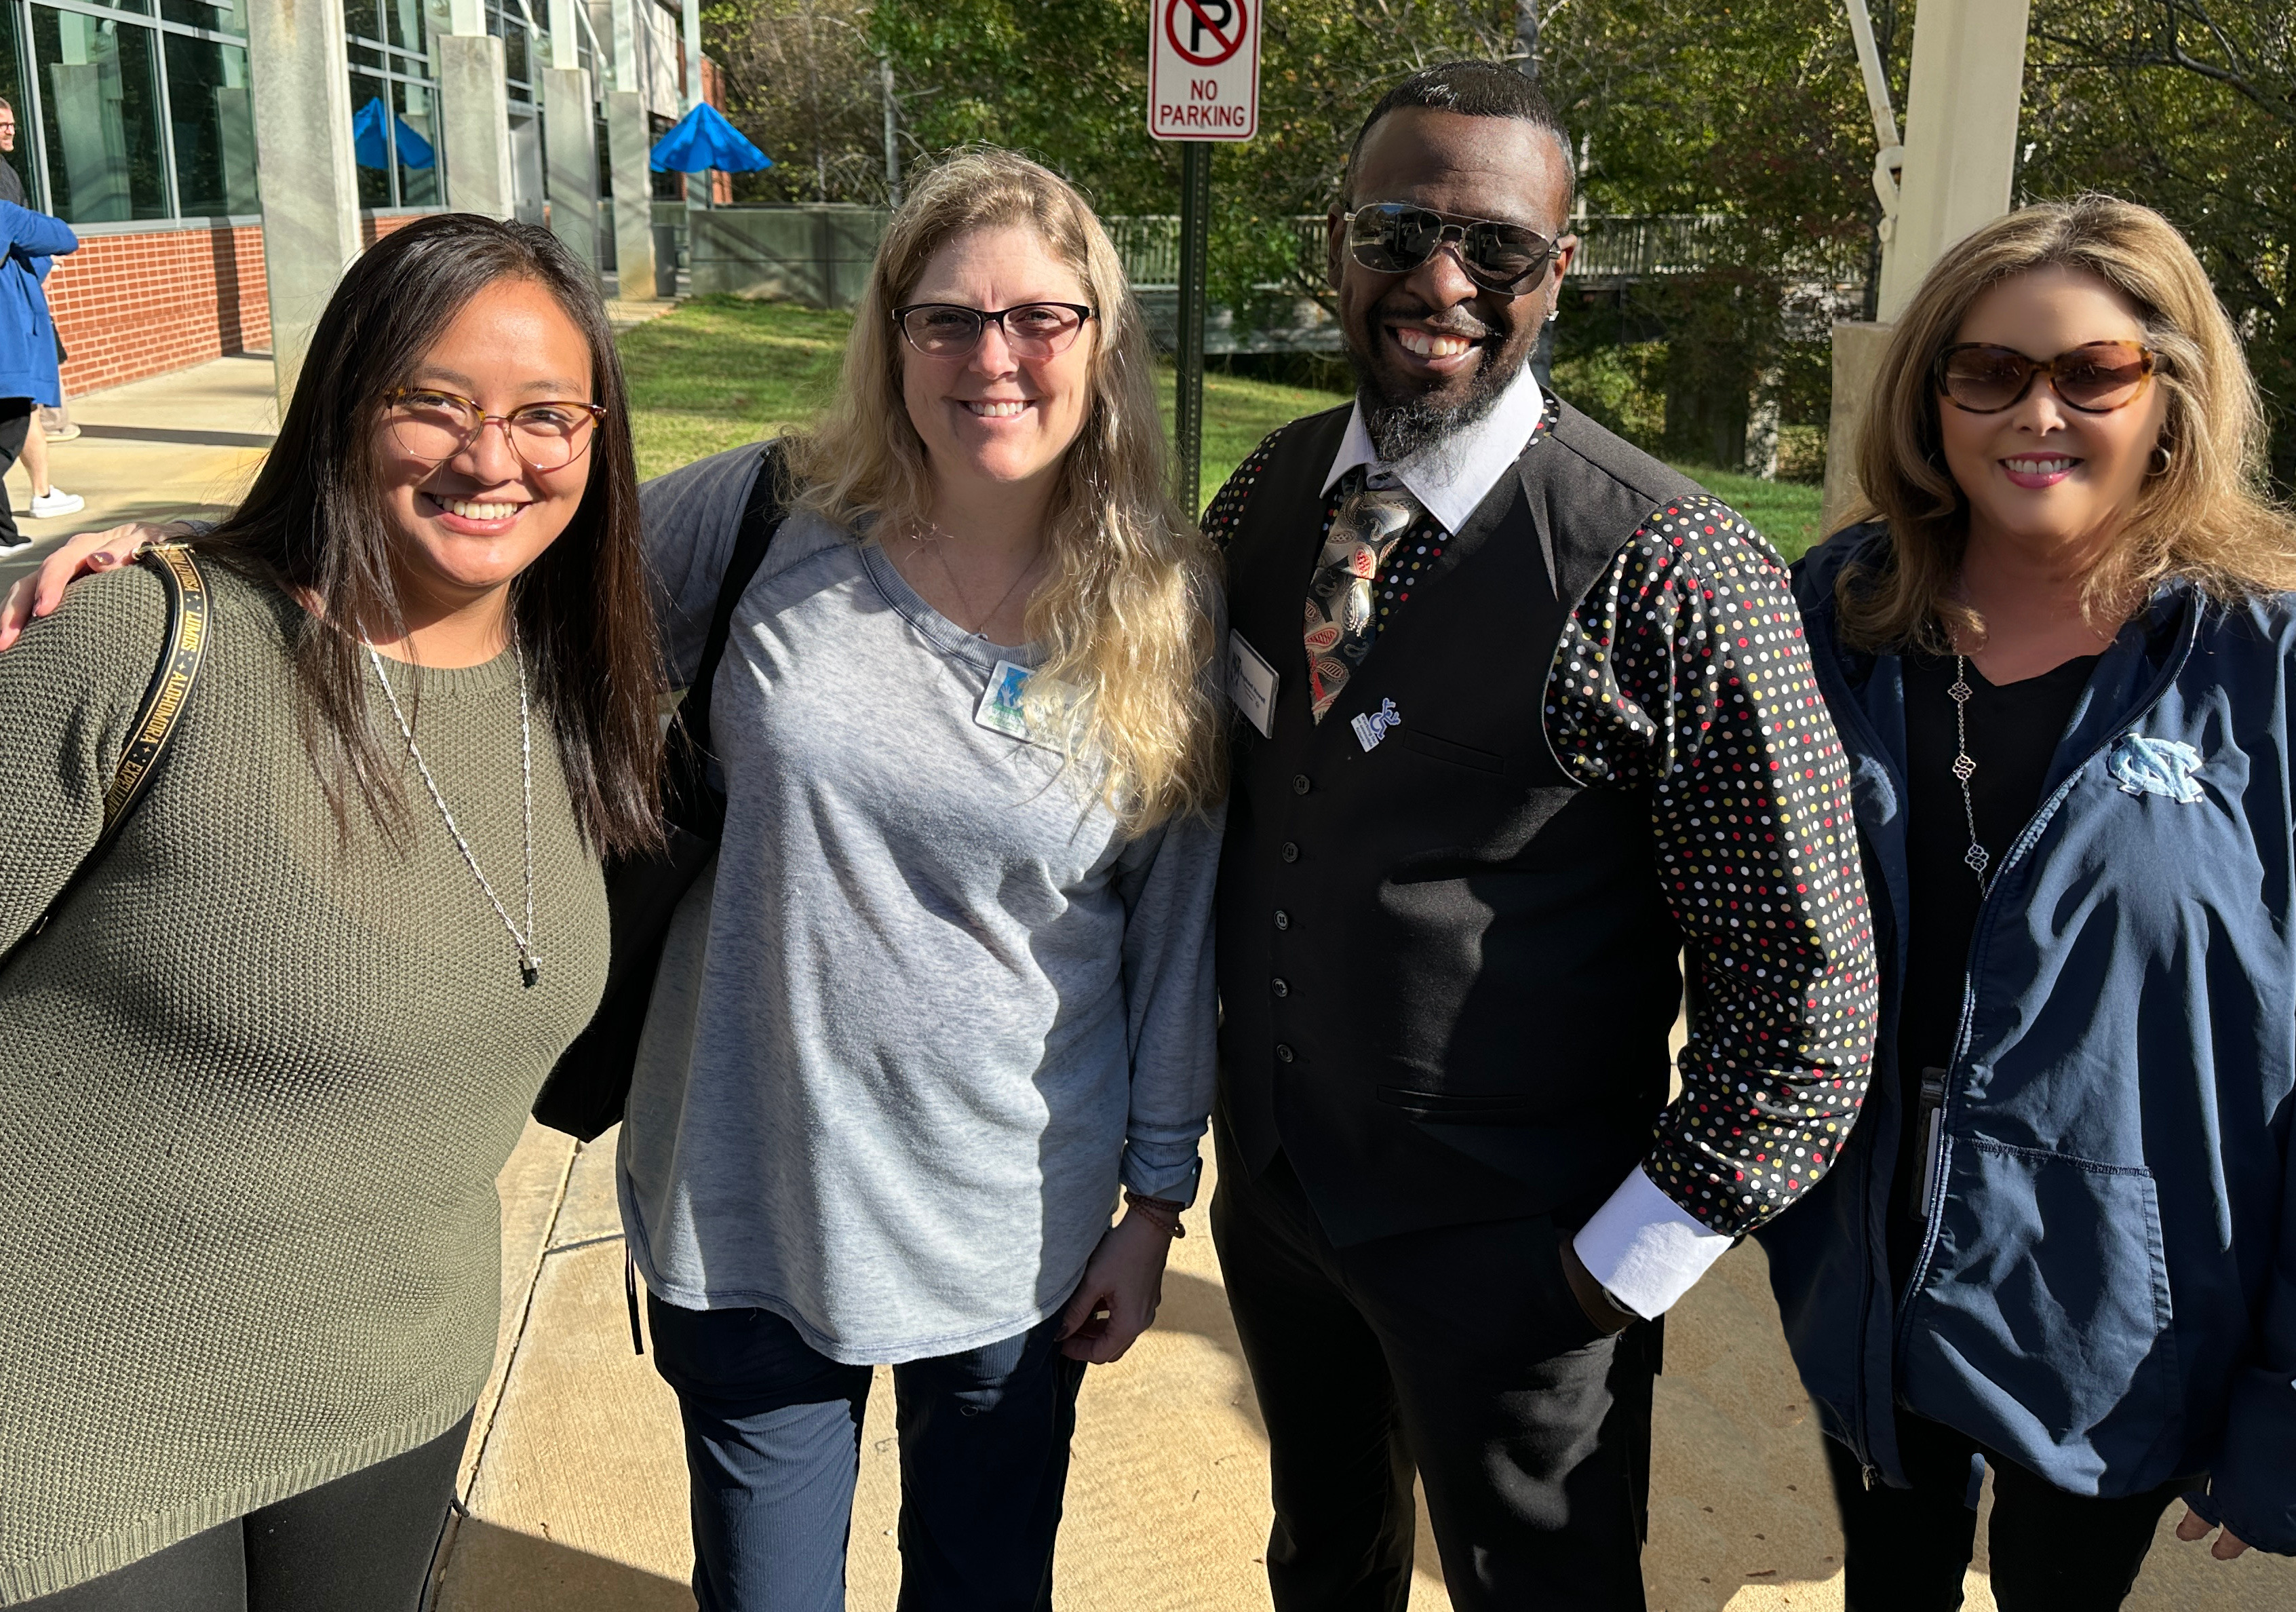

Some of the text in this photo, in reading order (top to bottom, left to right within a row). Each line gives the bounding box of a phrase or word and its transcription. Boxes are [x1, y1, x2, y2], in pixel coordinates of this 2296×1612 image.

[1190, 79, 1218, 101] NO
[1160, 104, 1245, 128] PARKING
[180, 610, 202, 653] LUMOS
[140, 670, 189, 744] ALOHOMORA
[104, 759, 144, 823] EXPELLIAR
